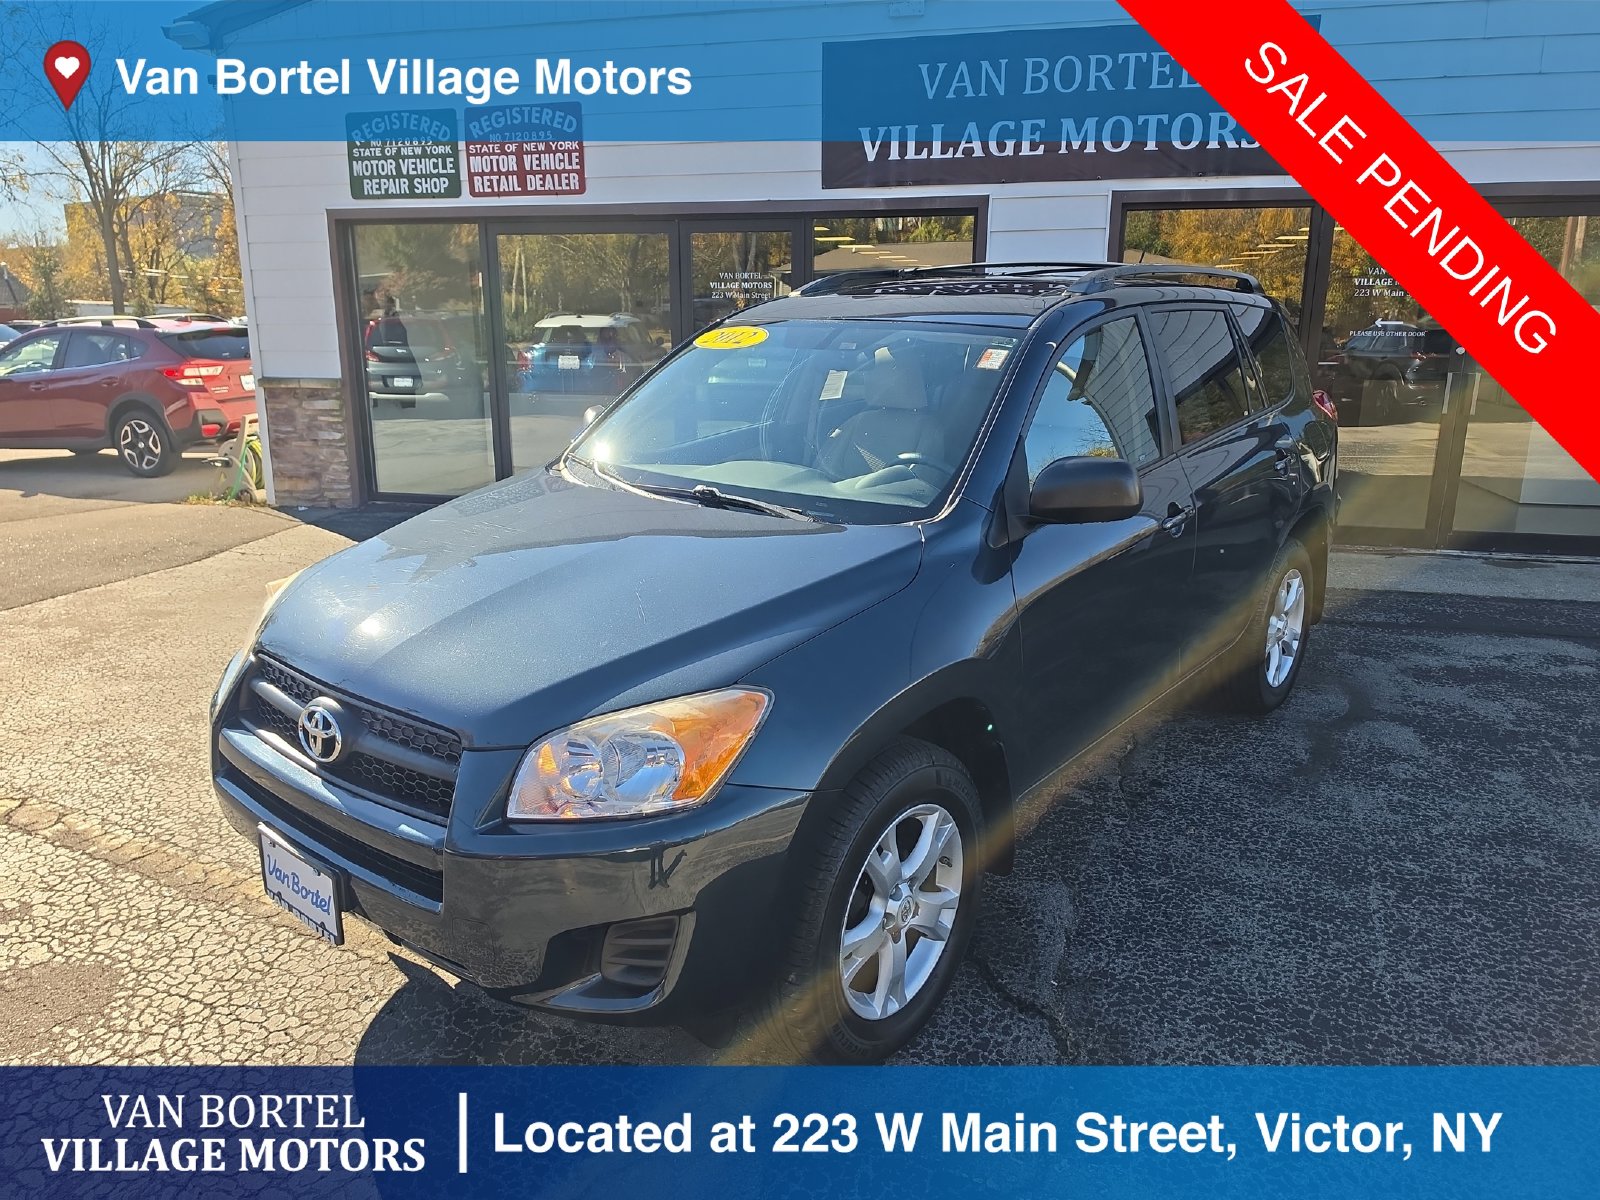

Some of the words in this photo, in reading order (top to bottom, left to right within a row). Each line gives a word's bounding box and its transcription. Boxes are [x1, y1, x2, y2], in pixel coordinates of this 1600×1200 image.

[918, 58, 1008, 100] VAN
[351, 112, 451, 146] REGISTERED
[468, 106, 577, 139] REGISTERED
[504, 130, 553, 141] 7120895
[858, 119, 1046, 162] VILLAGE
[353, 148, 382, 157] STATE
[385, 148, 397, 156] OF
[401, 147, 422, 155] NEW
[425, 145, 452, 154] YORK
[469, 144, 501, 154] STATE
[505, 143, 519, 152] OF
[523, 142, 545, 152] NEW
[550, 140, 579, 150] YORK
[352, 159, 396, 176] MOTOR
[399, 157, 455, 175] VEHICLE
[469, 155, 517, 173] MOTOR
[523, 152, 580, 171] VEHICLE
[363, 178, 409, 195] REPAIR
[413, 177, 449, 194] SHOP
[473, 175, 521, 193] RETAIL
[526, 173, 579, 191] DEALER
[1368, 267, 1387, 275] VAN
[1354, 278, 1393, 286] VILLAGE
[711, 291, 724, 299] 223
[725, 291, 733, 299] W
[751, 291, 771, 299] Street
[1354, 289, 1370, 297] 223
[1383, 289, 1404, 297] Main
